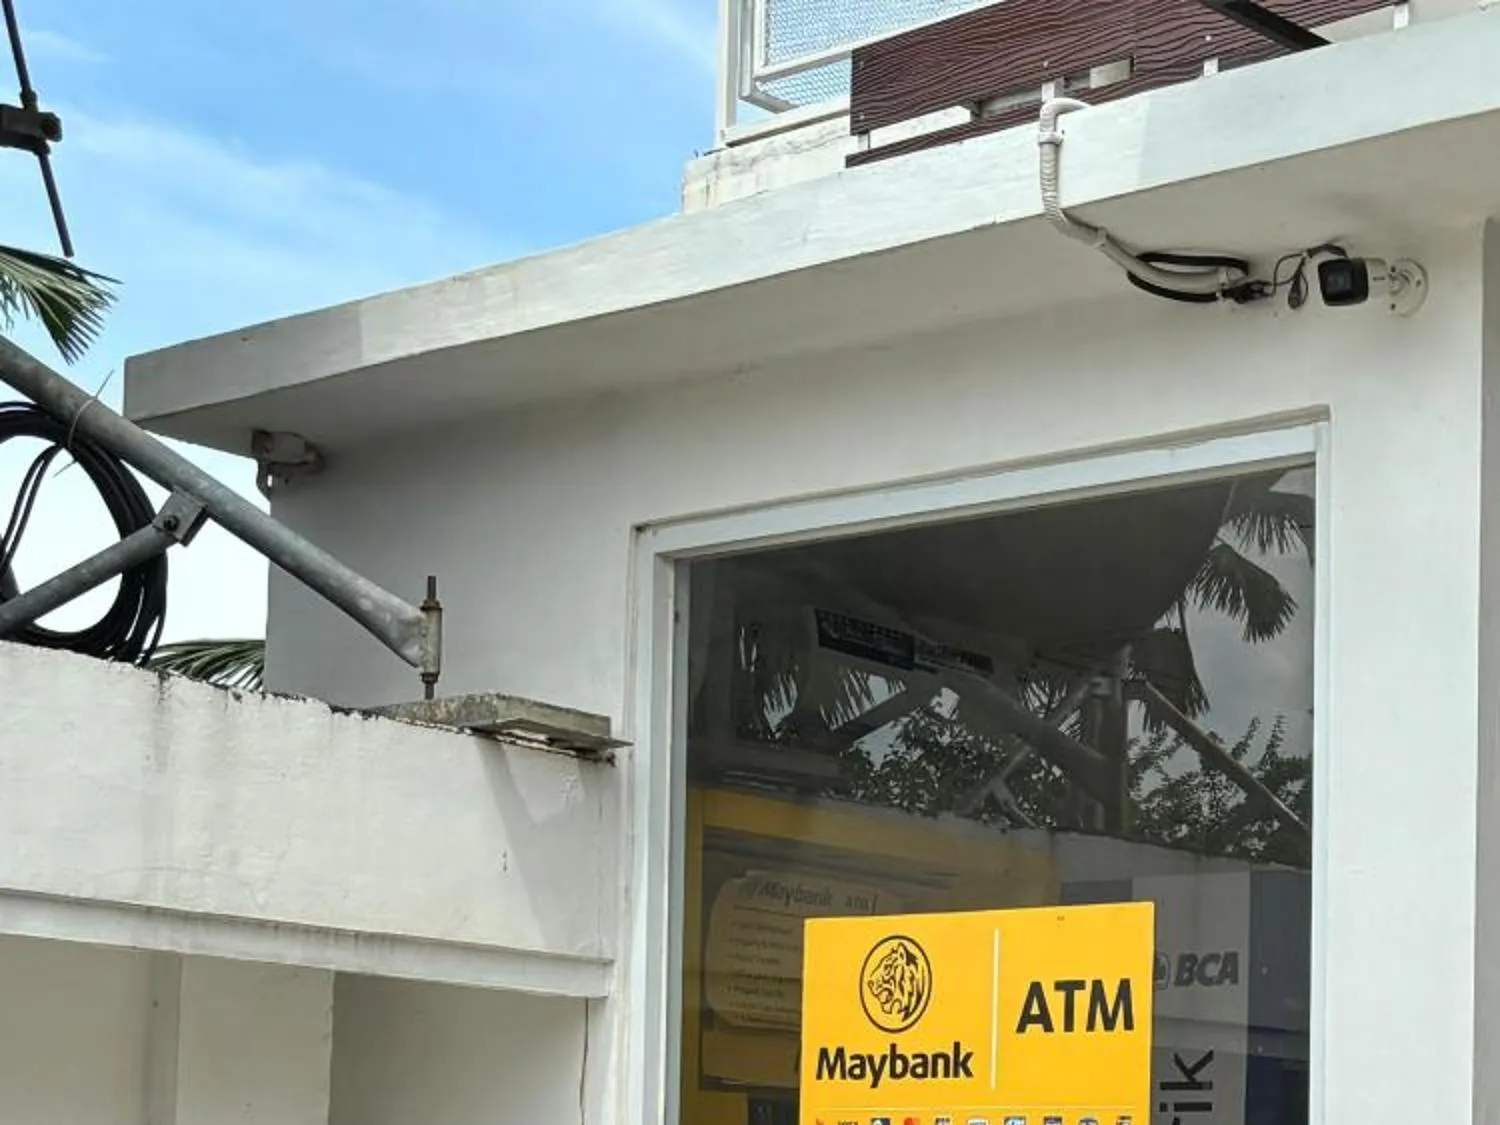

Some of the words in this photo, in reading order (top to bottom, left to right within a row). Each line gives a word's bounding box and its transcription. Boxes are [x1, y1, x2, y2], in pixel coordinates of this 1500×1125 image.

[1174, 951, 1239, 988] BCA
[1015, 977, 1135, 1033] ATM
[815, 1041, 974, 1089] Maybank
